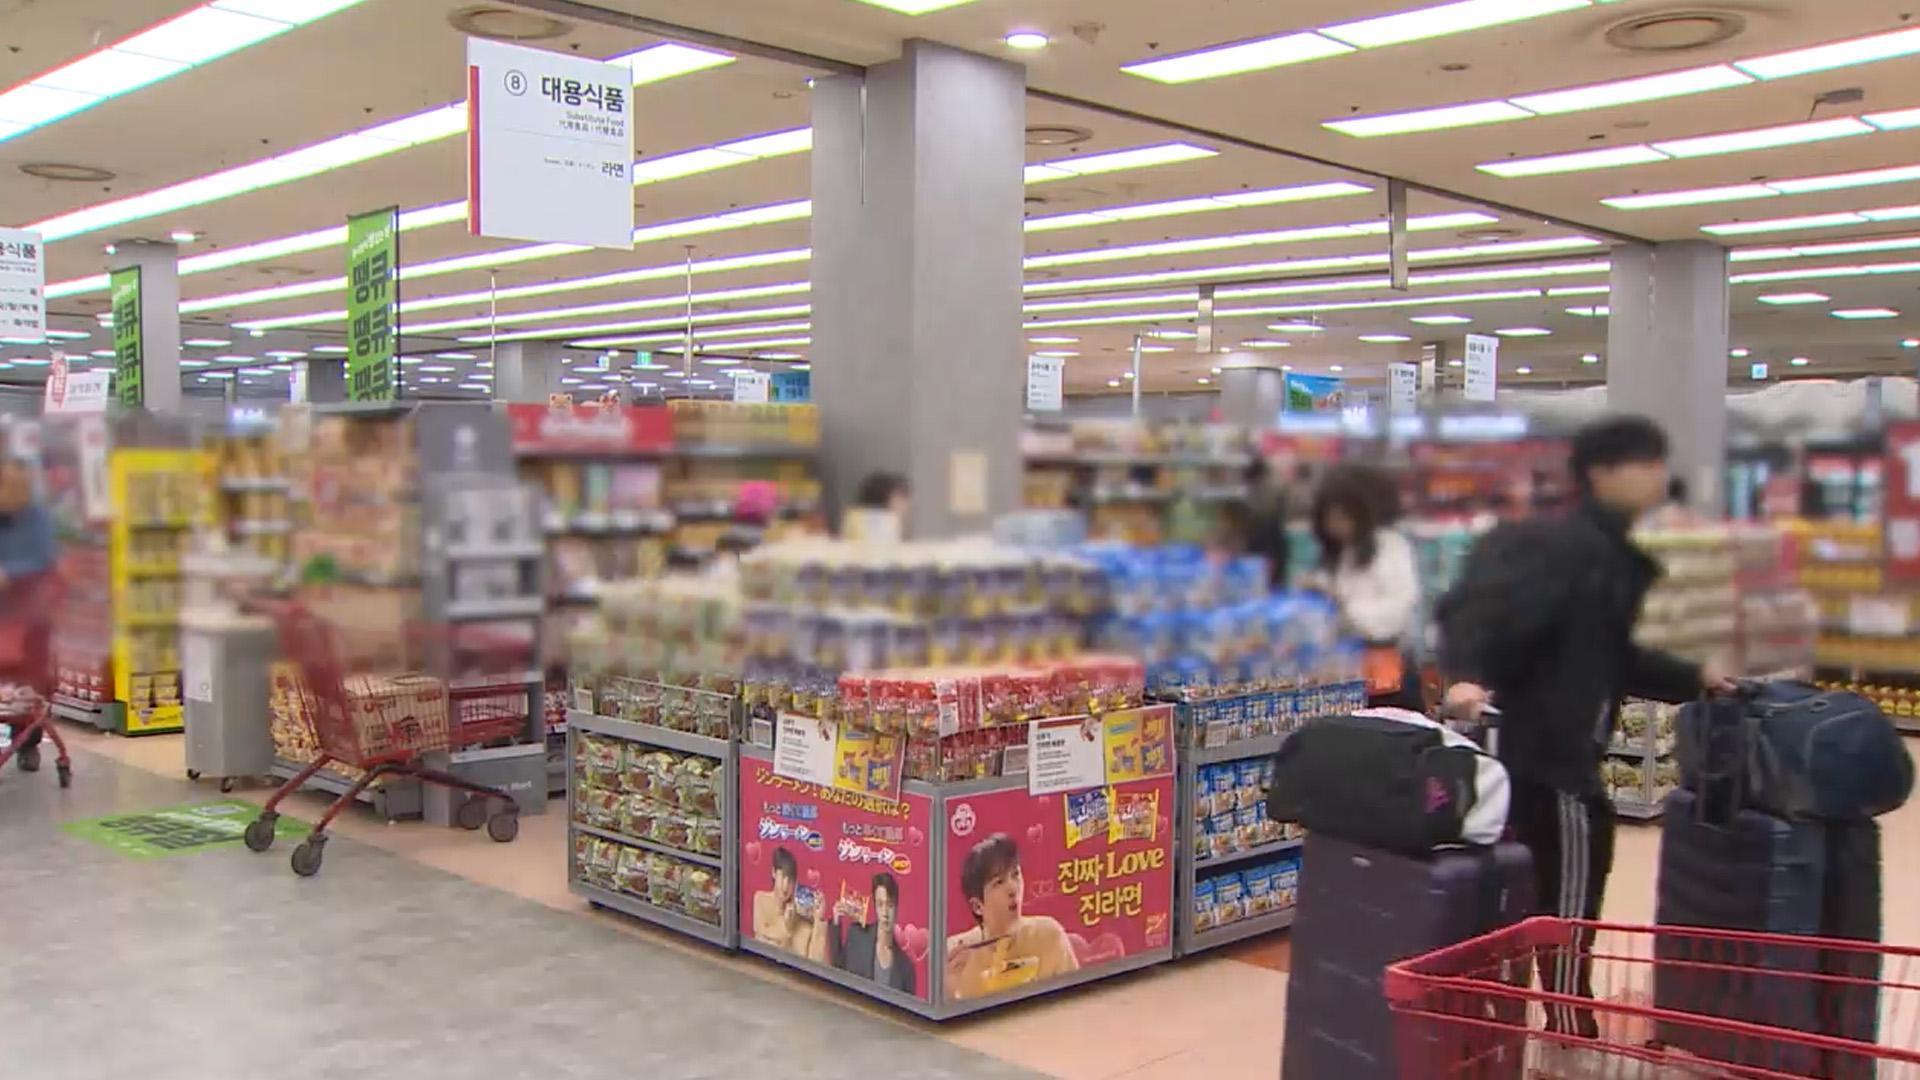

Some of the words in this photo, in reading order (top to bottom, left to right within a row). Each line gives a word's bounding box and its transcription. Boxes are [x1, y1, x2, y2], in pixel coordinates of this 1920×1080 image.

[541, 76, 624, 113] 대용식품
[602, 161, 624, 178] 라면
[1058, 854, 1104, 893] 진짜
[1106, 848, 1164, 878] Love
[1079, 882, 1143, 926] 진라면
